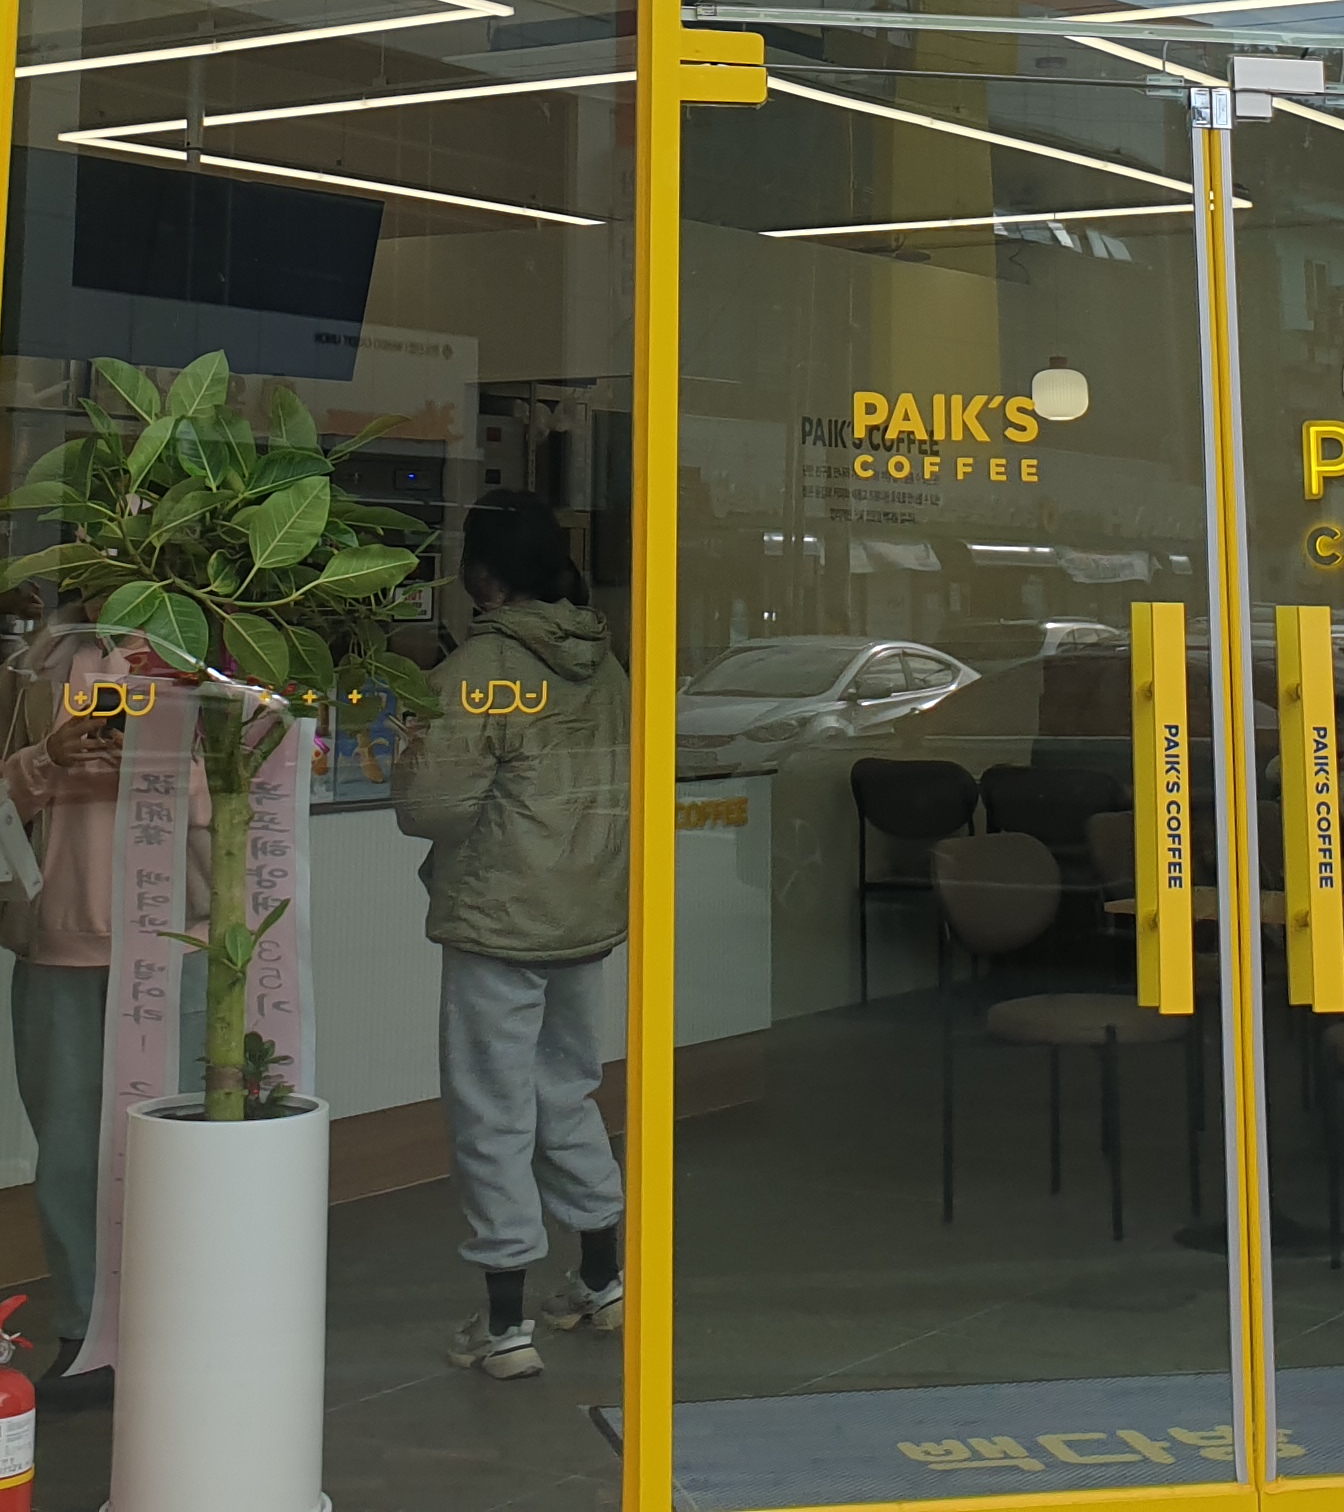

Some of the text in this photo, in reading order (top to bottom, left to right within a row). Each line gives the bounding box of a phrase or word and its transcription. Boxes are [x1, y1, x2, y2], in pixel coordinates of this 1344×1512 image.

[853, 391, 1040, 443] PAIK'S
[854, 455, 1039, 482] COFFEE
[1163, 724, 1183, 889] PAIK'S COFFEE
[1312, 726, 1334, 889] PAIK'S COFFEE
